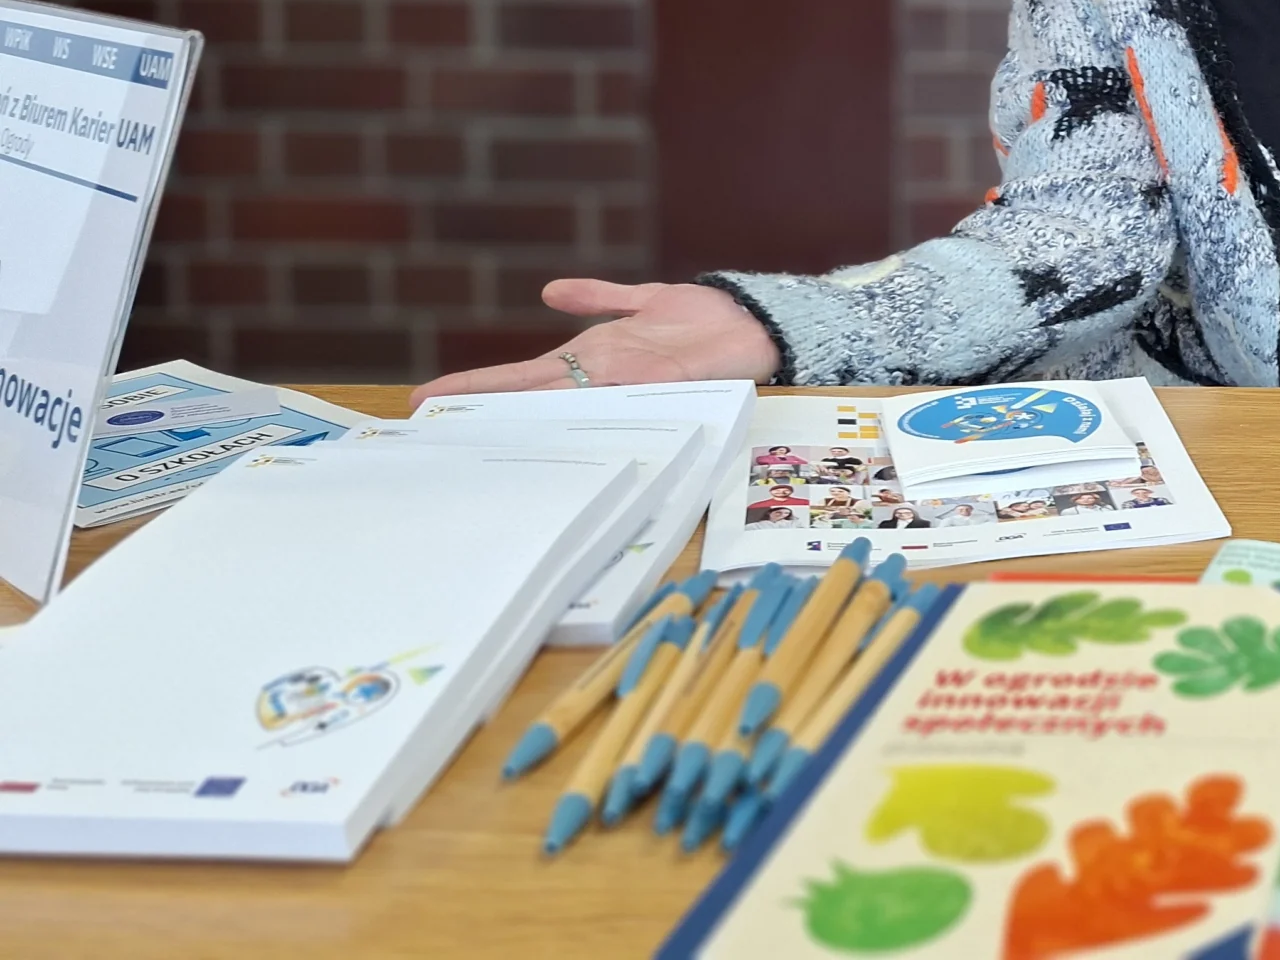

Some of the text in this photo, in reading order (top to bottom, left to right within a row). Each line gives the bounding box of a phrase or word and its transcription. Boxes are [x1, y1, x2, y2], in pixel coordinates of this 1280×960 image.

[52, 36, 72, 59] WS
[92, 44, 119, 69] WSE
[139, 53, 172, 81] UAM
[9, 97, 20, 118] z
[19, 93, 68, 132] Biurem
[68, 106, 115, 144] Karier
[116, 118, 156, 155] UAM
[115, 432, 273, 483] O SZKOŁACH
[934, 669, 1160, 691] W ogrodzie
[916, 690, 1122, 713] innowacji
[903, 712, 1168, 740] społecznych
